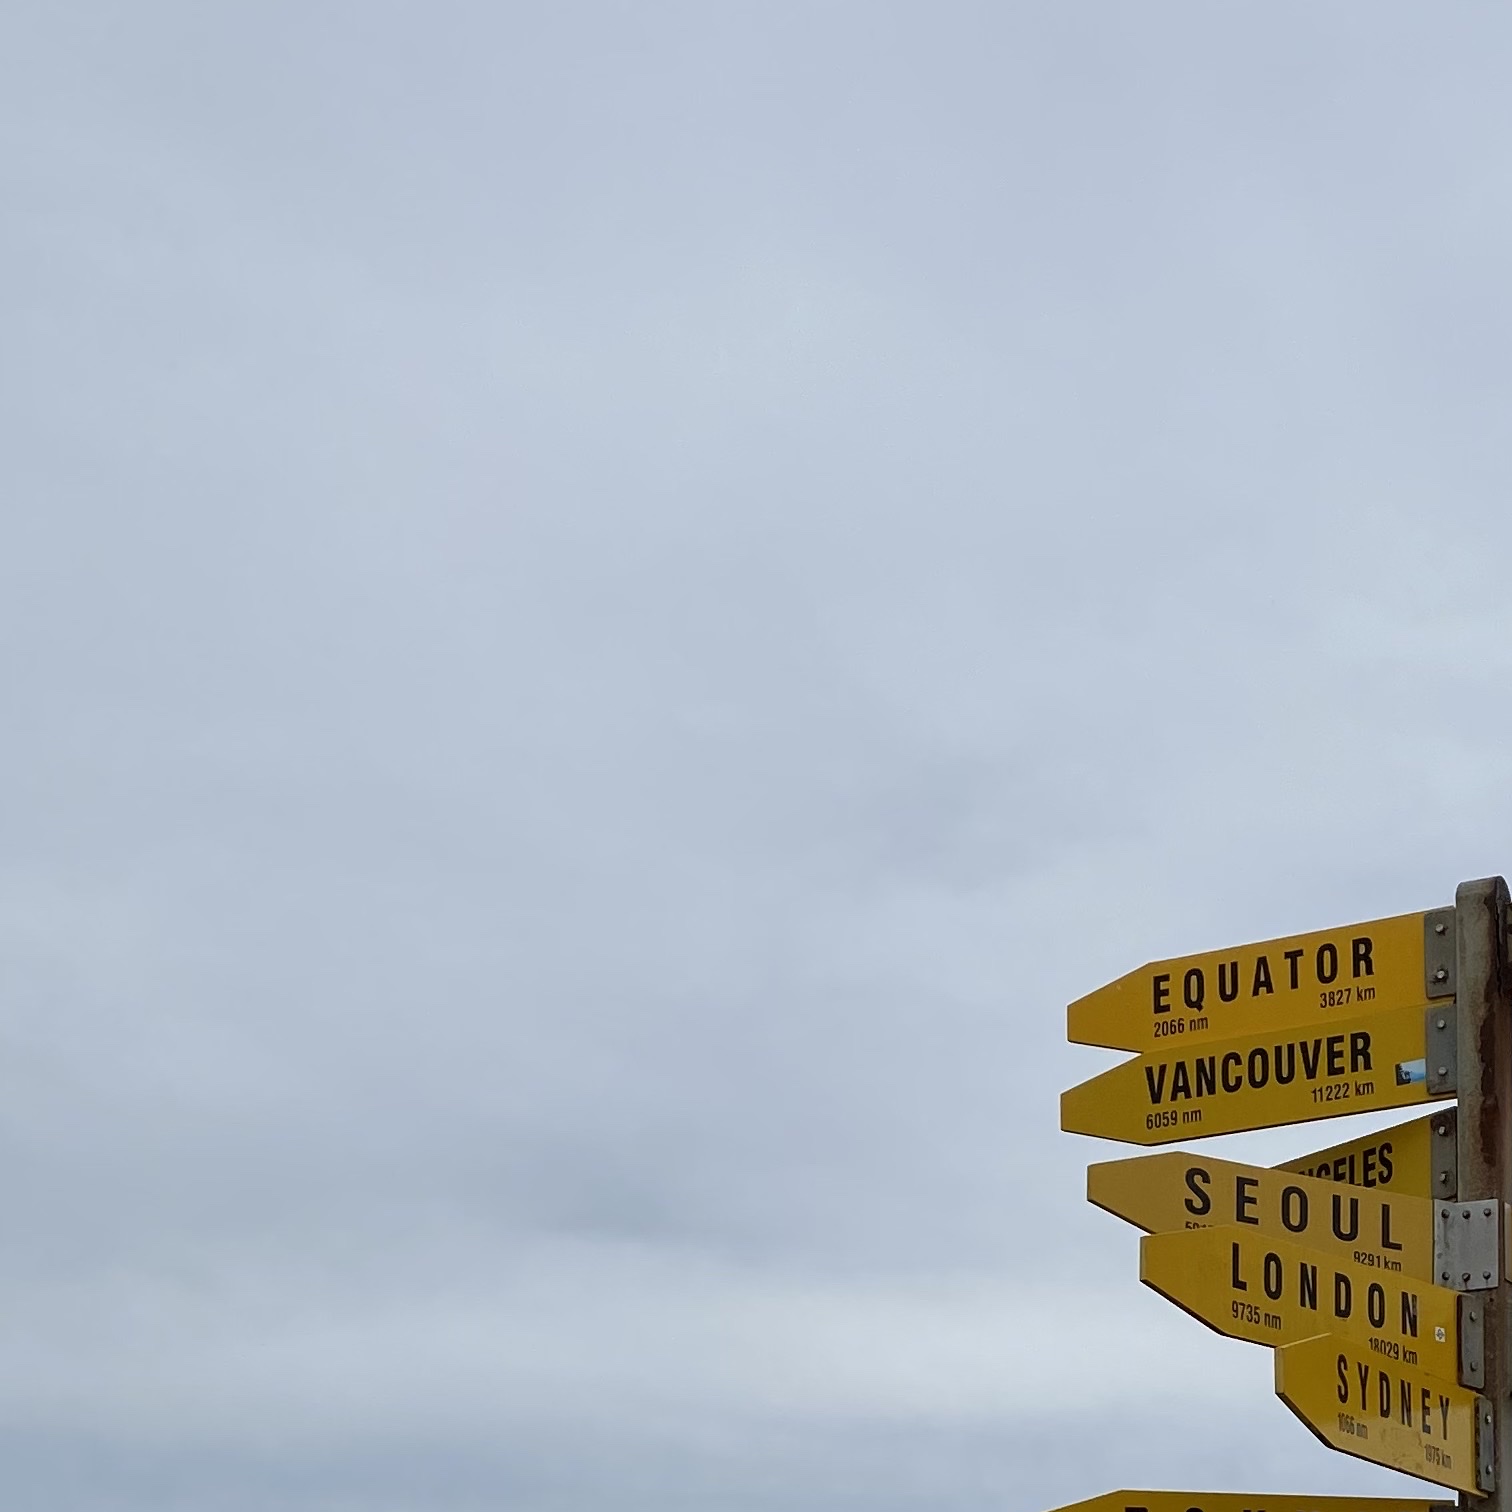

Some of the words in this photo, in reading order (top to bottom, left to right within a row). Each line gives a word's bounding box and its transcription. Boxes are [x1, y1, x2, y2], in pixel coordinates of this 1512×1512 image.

[1153, 937, 1375, 1015] EQUATOR
[1319, 986, 1351, 1009] 3827
[1356, 984, 1376, 1003] km
[1153, 1017, 1185, 1038] 2066
[1189, 1015, 1208, 1032] nm
[1145, 1031, 1373, 1105] VANCOUVER
[1311, 1082, 1350, 1104] 11222
[1354, 1080, 1374, 1097] km
[1146, 1109, 1178, 1130] 6059
[1183, 1106, 1202, 1123] nm
[1184, 1167, 1403, 1251] SEOUL
[1353, 1250, 1381, 1269] 9291
[1383, 1255, 1402, 1273] km
[1231, 1242, 1418, 1338] LONDON
[1231, 1301, 1260, 1325] 9735
[1264, 1312, 1282, 1331] nm
[1368, 1336, 1400, 1361] 18029
[1402, 1345, 1418, 1366] km
[1337, 1353, 1450, 1441] SYDNEY
